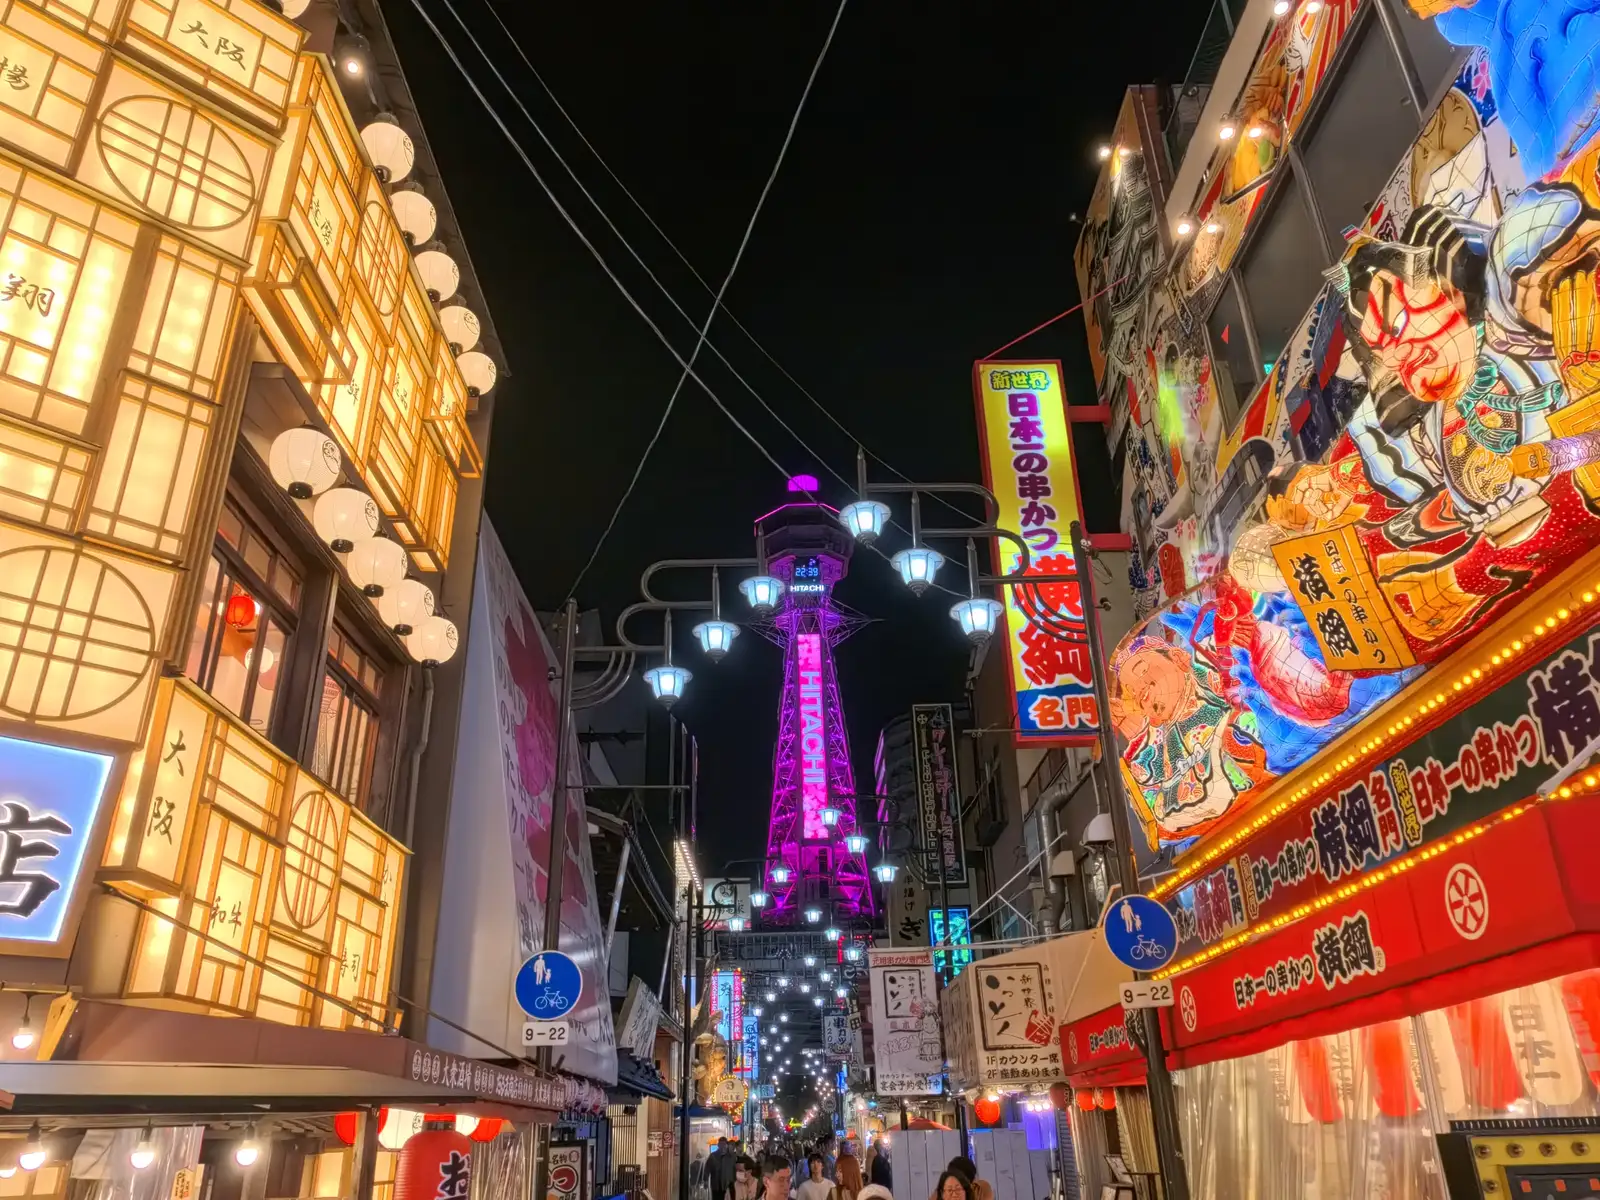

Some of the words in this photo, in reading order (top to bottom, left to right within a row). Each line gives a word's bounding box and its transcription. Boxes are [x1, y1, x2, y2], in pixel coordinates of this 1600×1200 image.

[180, 20, 246, 71] 大阪
[991, 370, 1050, 391] 新世界
[1006, 392, 1058, 552] 日本一の串かつ
[790, 584, 825, 592] HITACHI
[1323, 539, 1386, 664] 日本一の串かつ
[801, 671, 825, 783] HITACHI
[1031, 695, 1100, 727] 名門
[1411, 716, 1540, 824] 日本一の串かつ
[1527, 632, 1600, 771] 横
[146, 730, 187, 846] 大阪
[1252, 837, 1318, 904] 日本一の串かつ
[1311, 780, 1382, 882] 横綱
[1370, 771, 1403, 857] 名門
[211, 897, 242, 938] 和牛
[1226, 865, 1245, 928] 名門
[1234, 955, 1315, 1010] 日本一の串かつ
[1313, 910, 1377, 990] 横綱
[1123, 985, 1170, 1004] 9-22
[525, 1027, 566, 1042] 9-22
[987, 1069, 997, 1079] 2F
